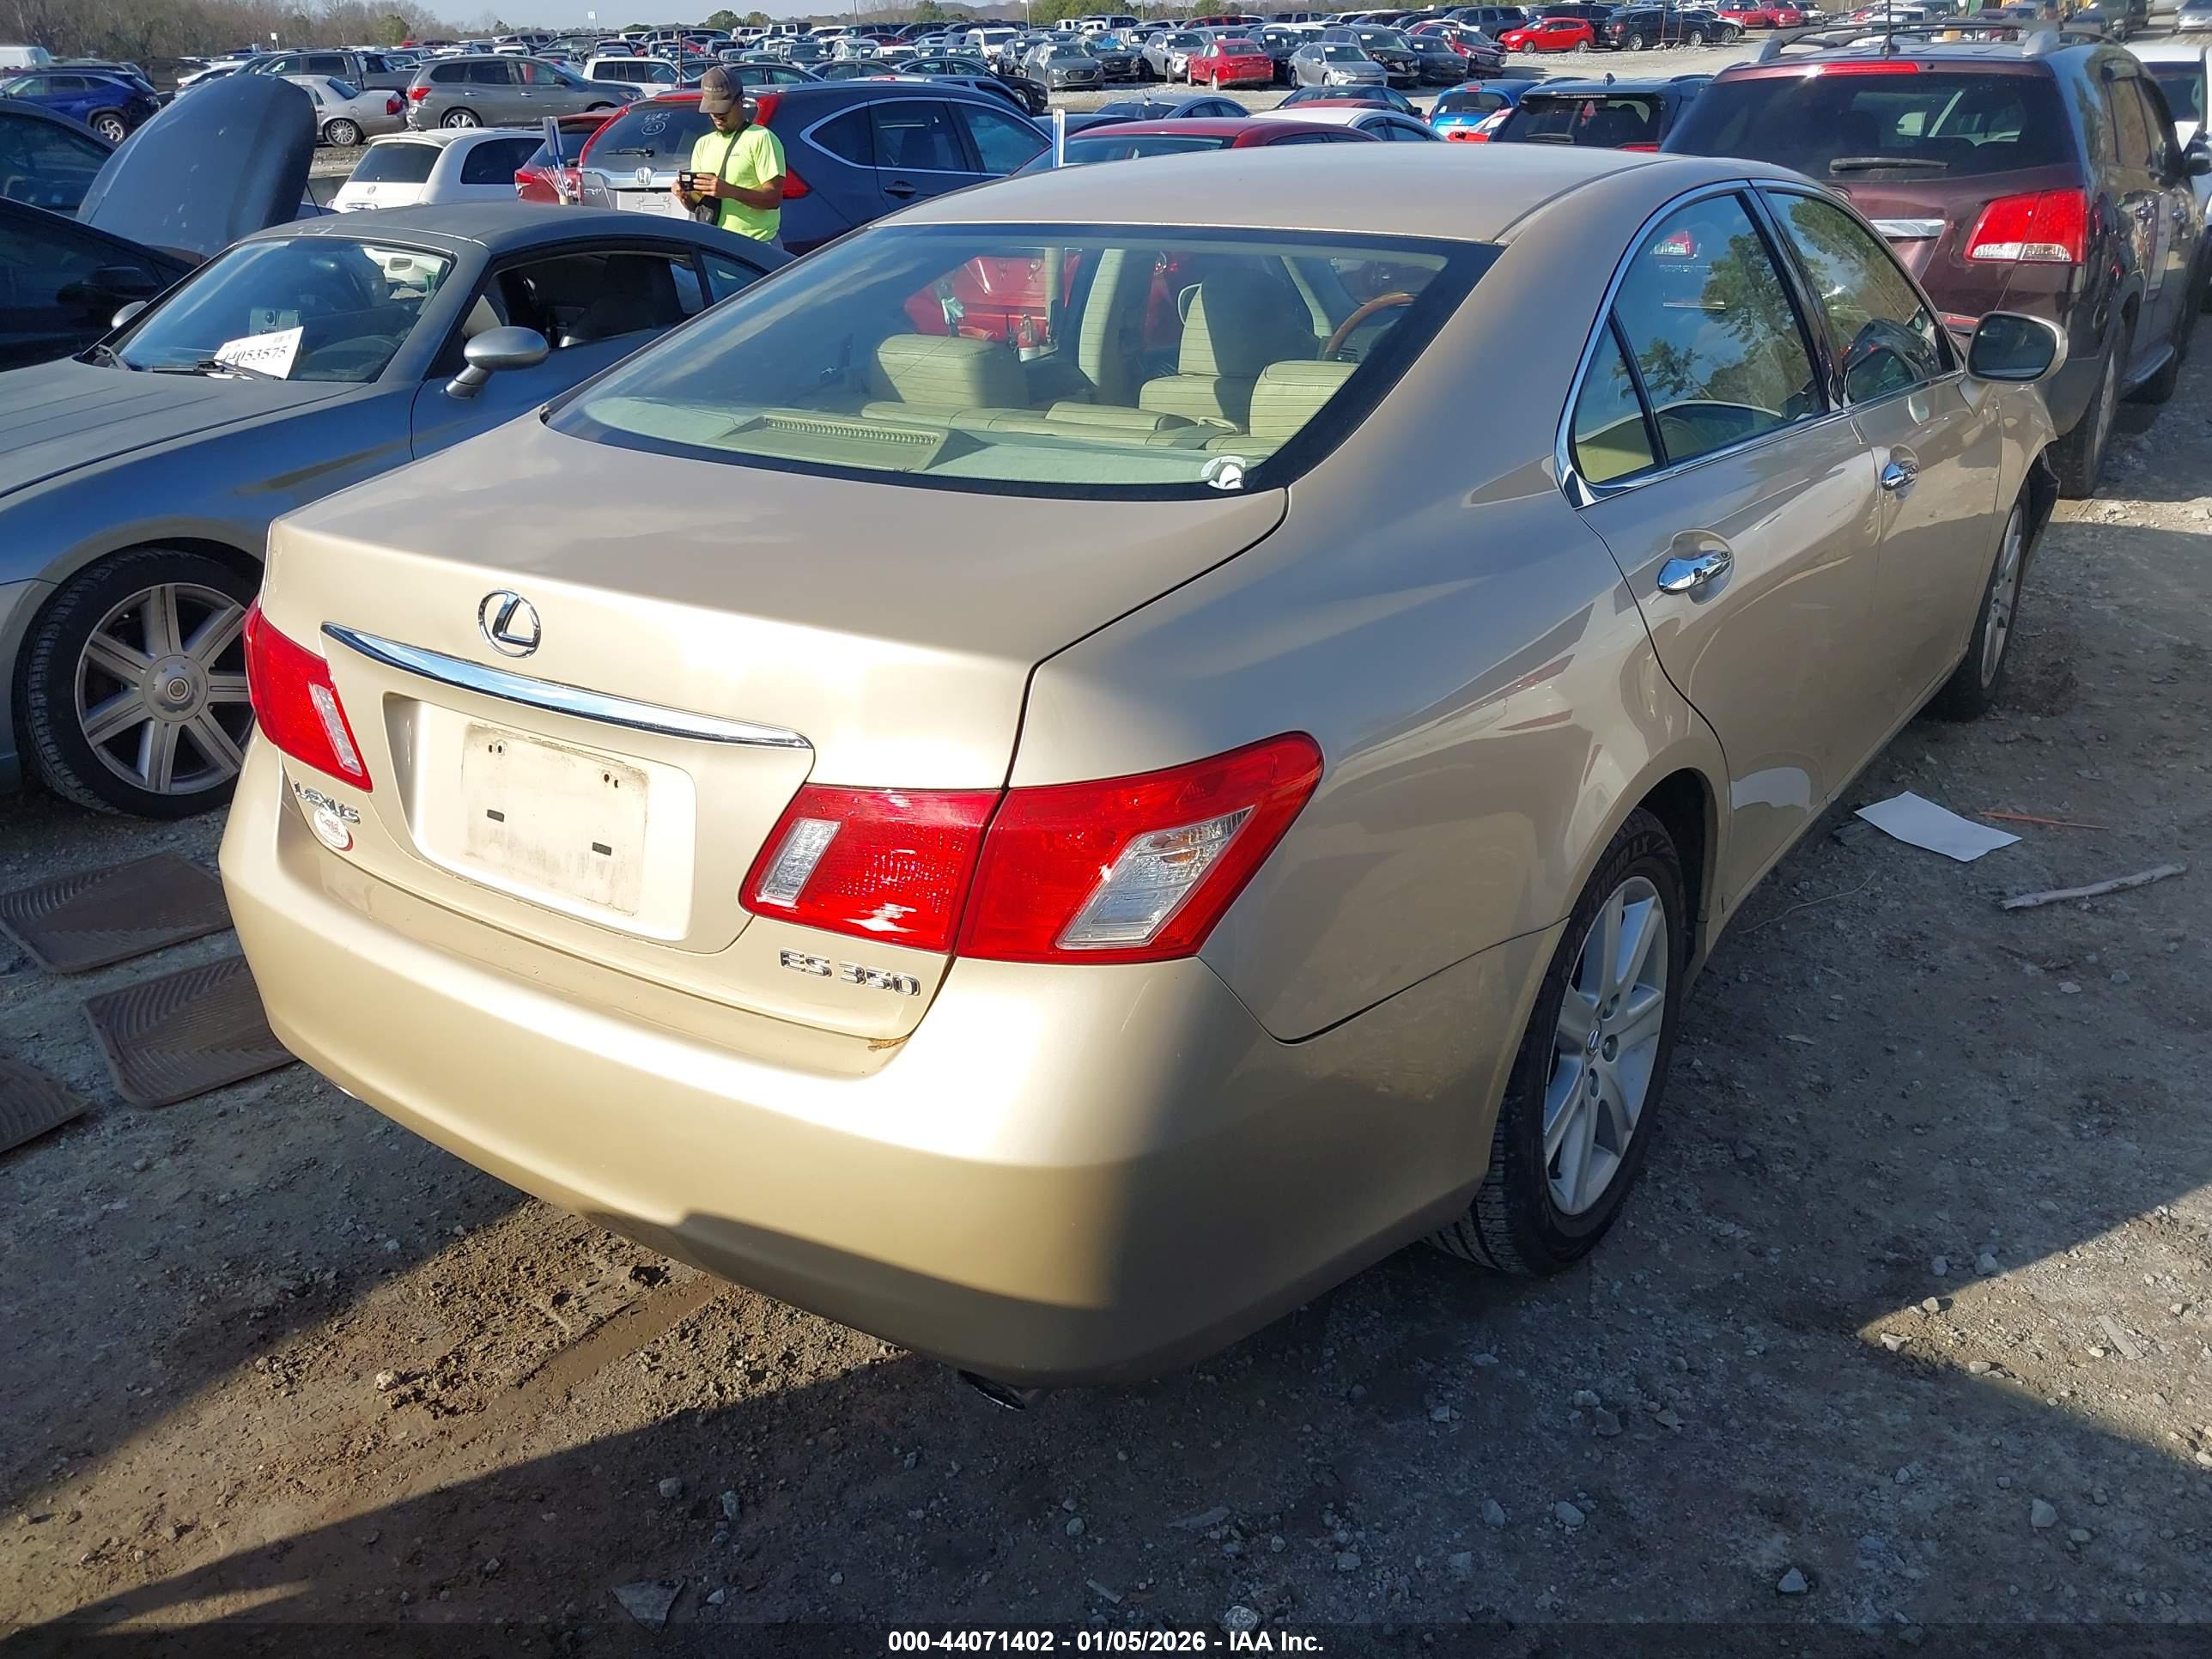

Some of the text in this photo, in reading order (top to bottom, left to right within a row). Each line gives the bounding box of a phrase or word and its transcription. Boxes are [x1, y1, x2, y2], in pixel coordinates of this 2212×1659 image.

[294, 781, 362, 824] LEXUS
[780, 948, 921, 996] ES 350
